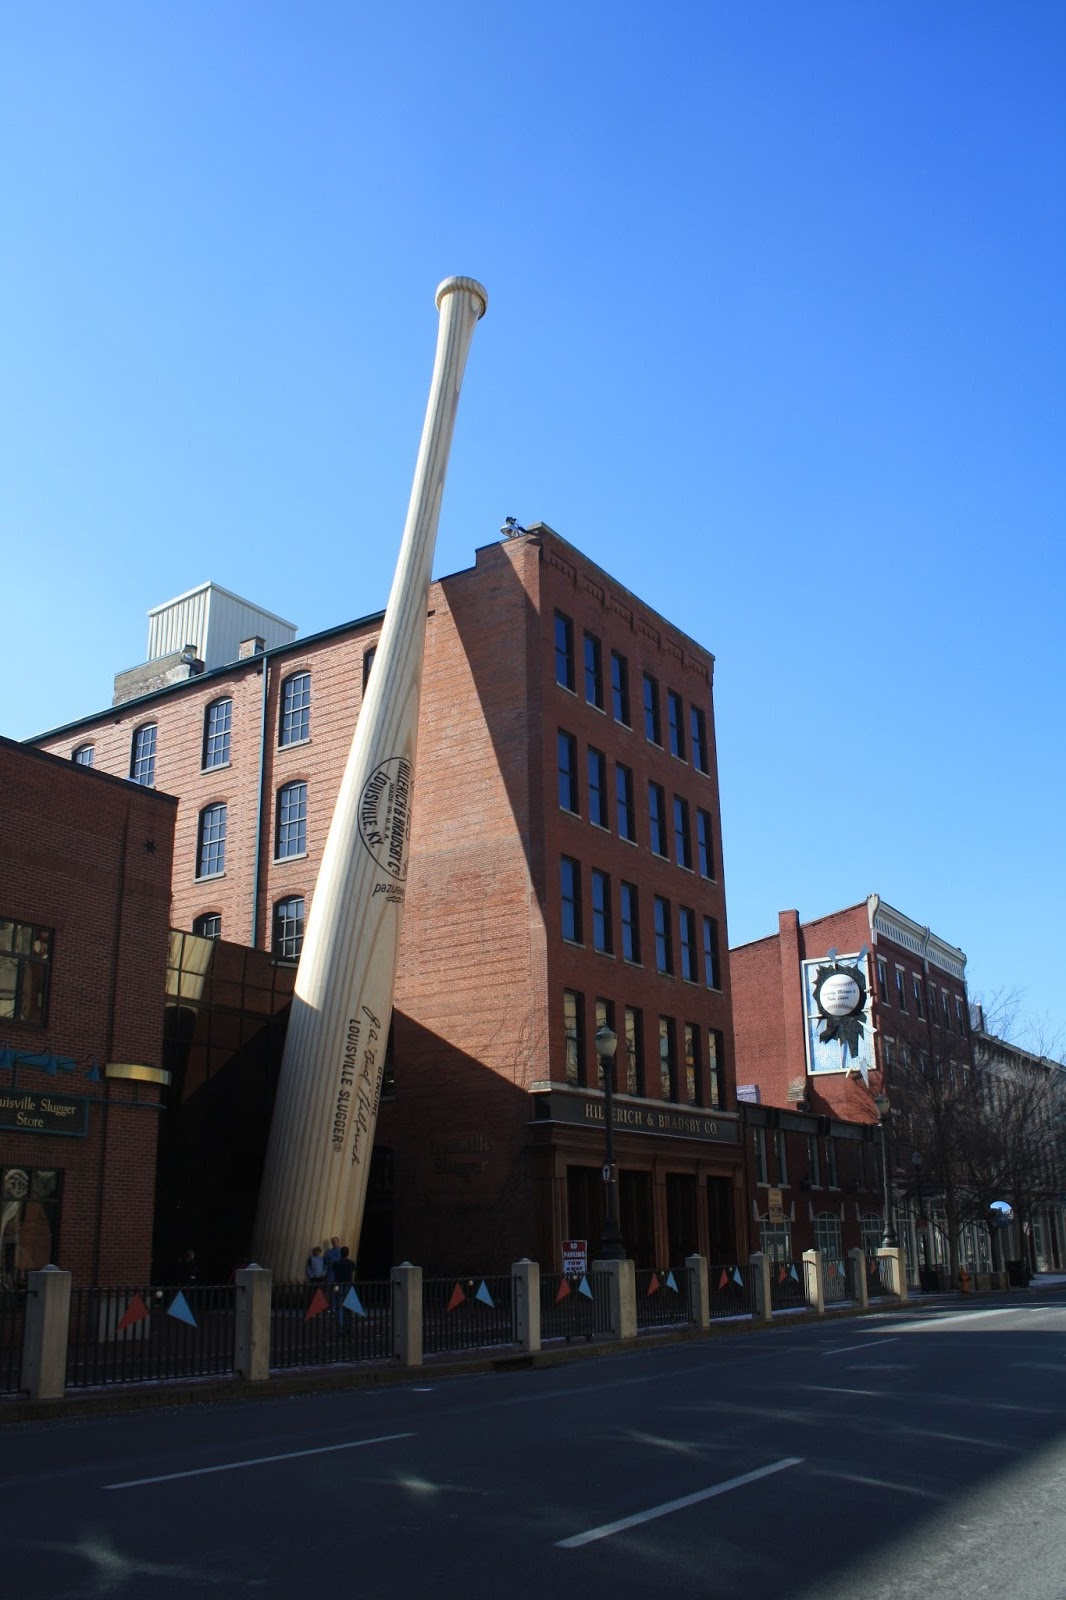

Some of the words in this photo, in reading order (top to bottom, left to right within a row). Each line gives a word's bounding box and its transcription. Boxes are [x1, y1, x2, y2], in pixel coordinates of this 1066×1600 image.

[393, 760, 411, 809] HILLERICH
[389, 816, 405, 862] BRADSBY
[340, 1018, 361, 1087] LOUISVILLE
[16, 1111, 45, 1128] Store
[40, 1097, 77, 1117] Slugger
[647, 1109, 654, 1127] &
[658, 1114, 701, 1133] BRADSBY
